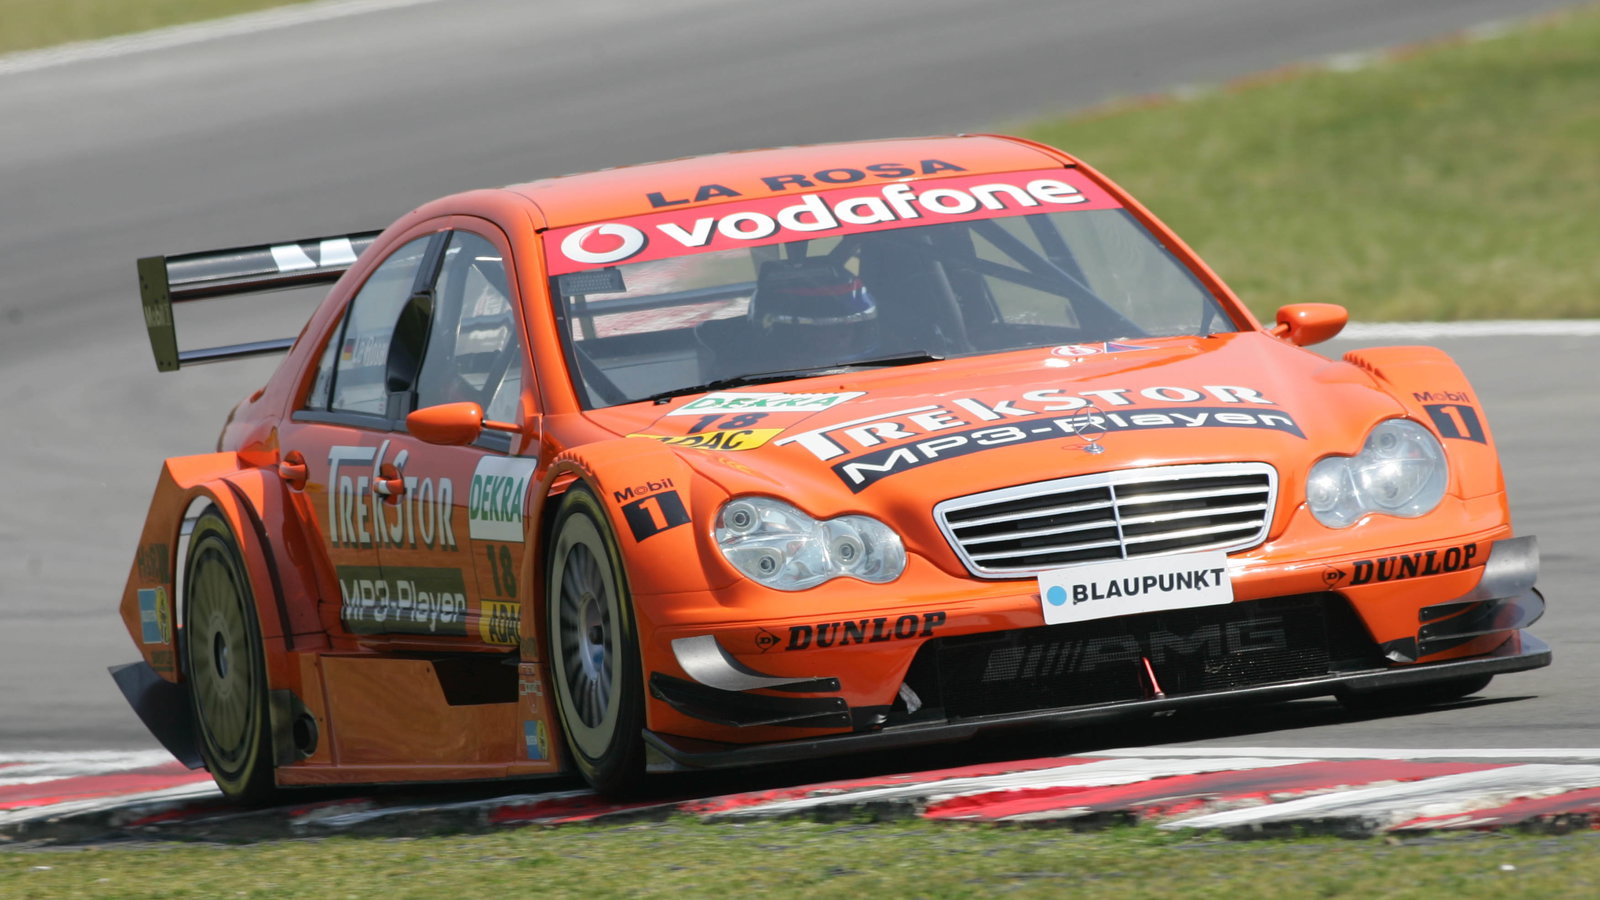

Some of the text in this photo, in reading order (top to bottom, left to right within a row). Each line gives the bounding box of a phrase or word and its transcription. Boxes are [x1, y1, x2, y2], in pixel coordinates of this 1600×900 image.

[646, 158, 967, 209] LA ROSA
[656, 178, 1088, 249] vodafone
[682, 396, 841, 411] DEKRA
[1413, 391, 1471, 404] Mobil
[686, 411, 770, 434] 18
[1440, 405, 1471, 439] 1
[470, 474, 524, 522] DEKRA
[613, 478, 674, 504] Mobil
[638, 496, 669, 530] 1
[486, 544, 518, 599] 18
[1349, 542, 1477, 586] DUNLOP
[340, 578, 468, 633] MP3-Player
[1072, 567, 1225, 605] BLAUPUNKT
[785, 611, 947, 651] DUNLOP
